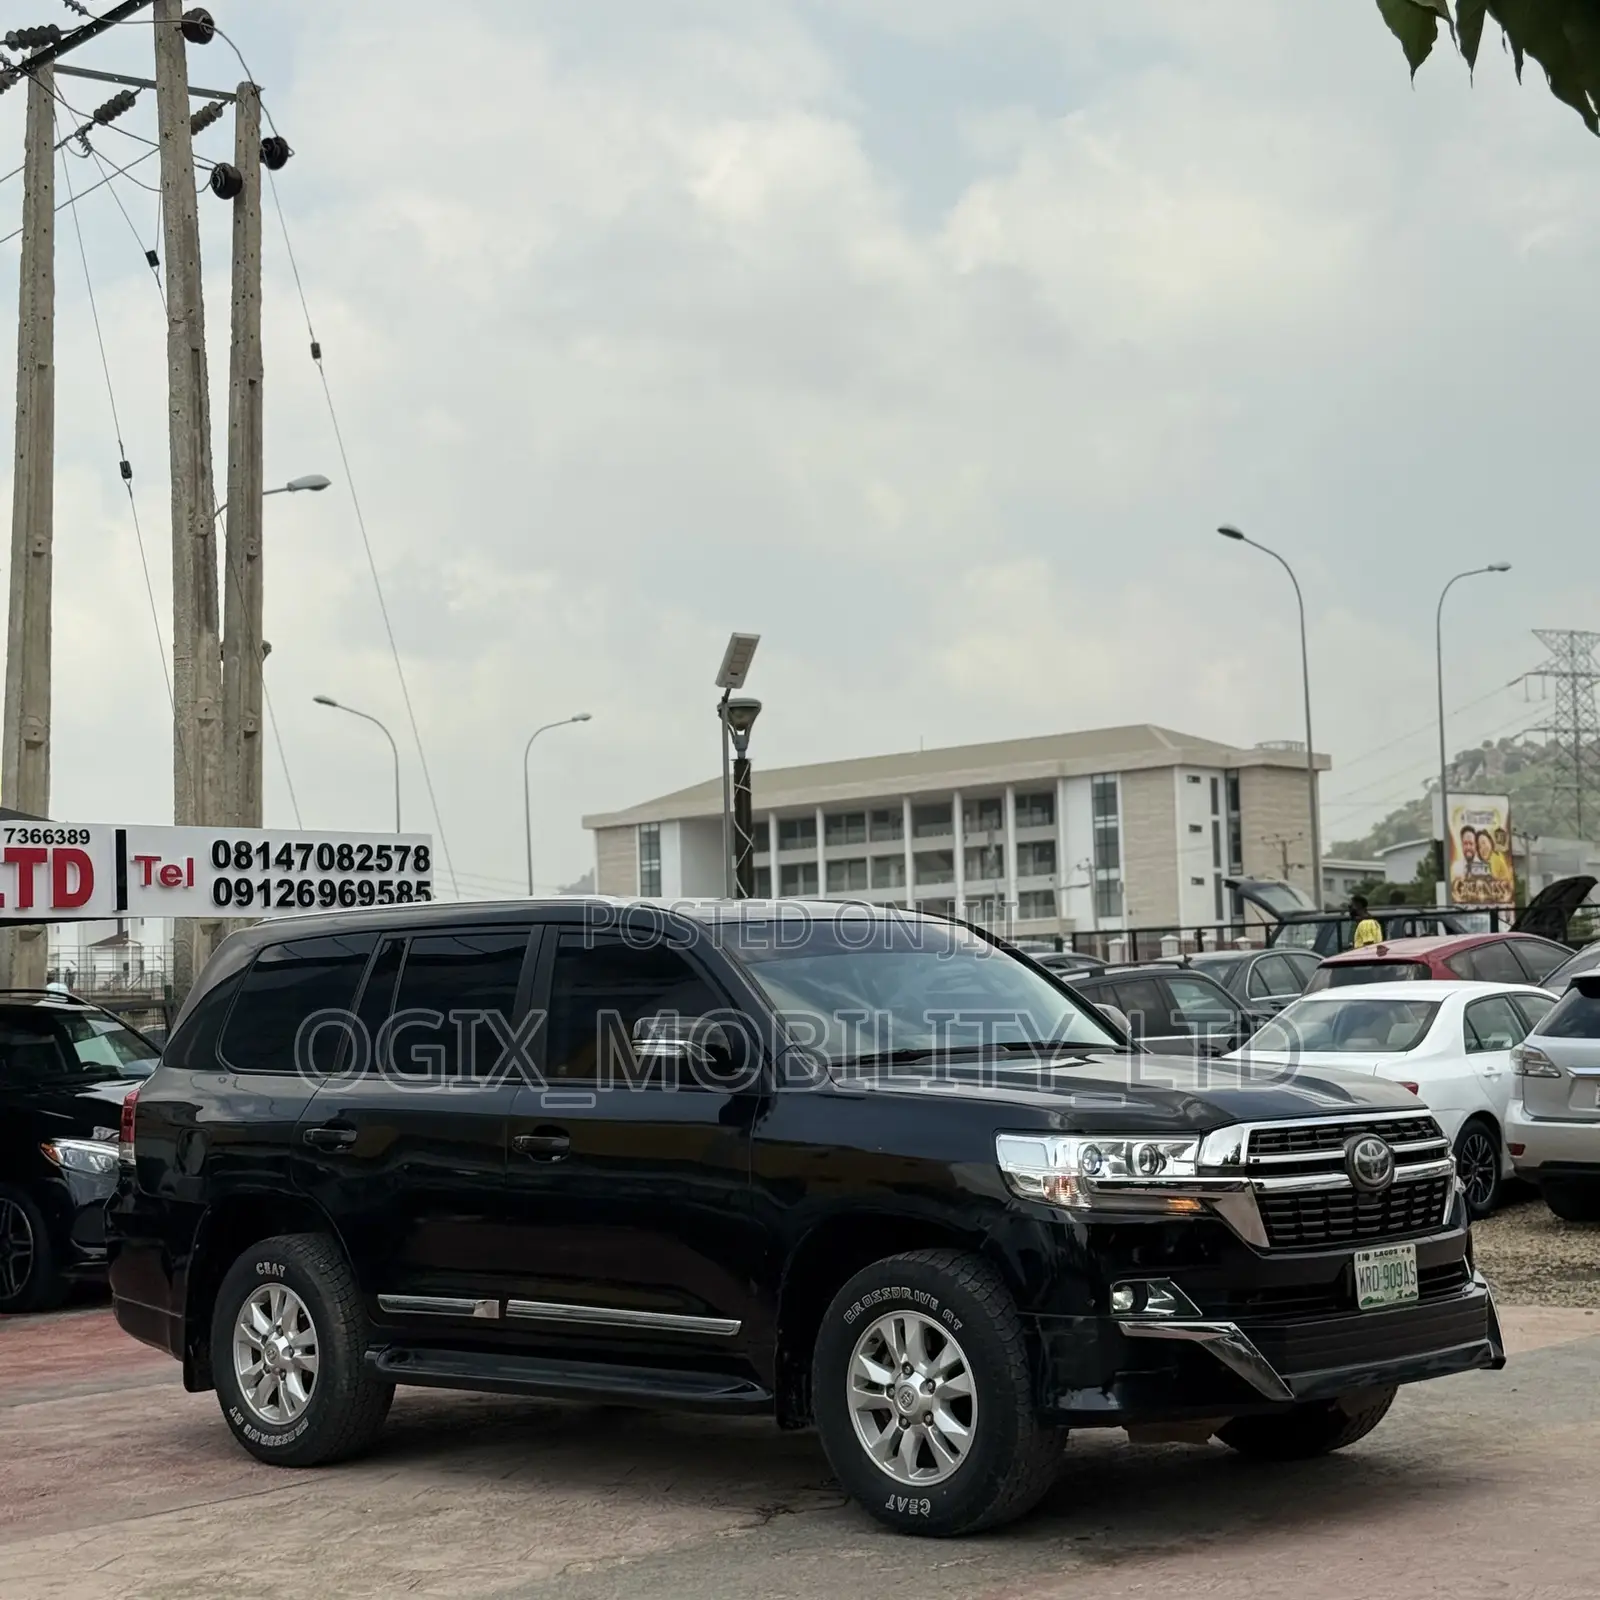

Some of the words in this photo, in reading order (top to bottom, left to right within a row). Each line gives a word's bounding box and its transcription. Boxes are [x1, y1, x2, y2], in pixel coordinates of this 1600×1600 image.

[3, 828, 91, 845] 7366389
[134, 855, 195, 887] Tel
[211, 839, 431, 873] 08147082578
[0, 847, 95, 909] TD
[212, 877, 432, 908] 09126969585
[256, 1262, 286, 1277] CEAT
[844, 1287, 939, 1325] CROSSDRIVE
[942, 1309, 963, 1331] AT
[885, 1494, 931, 1518] CEAT
